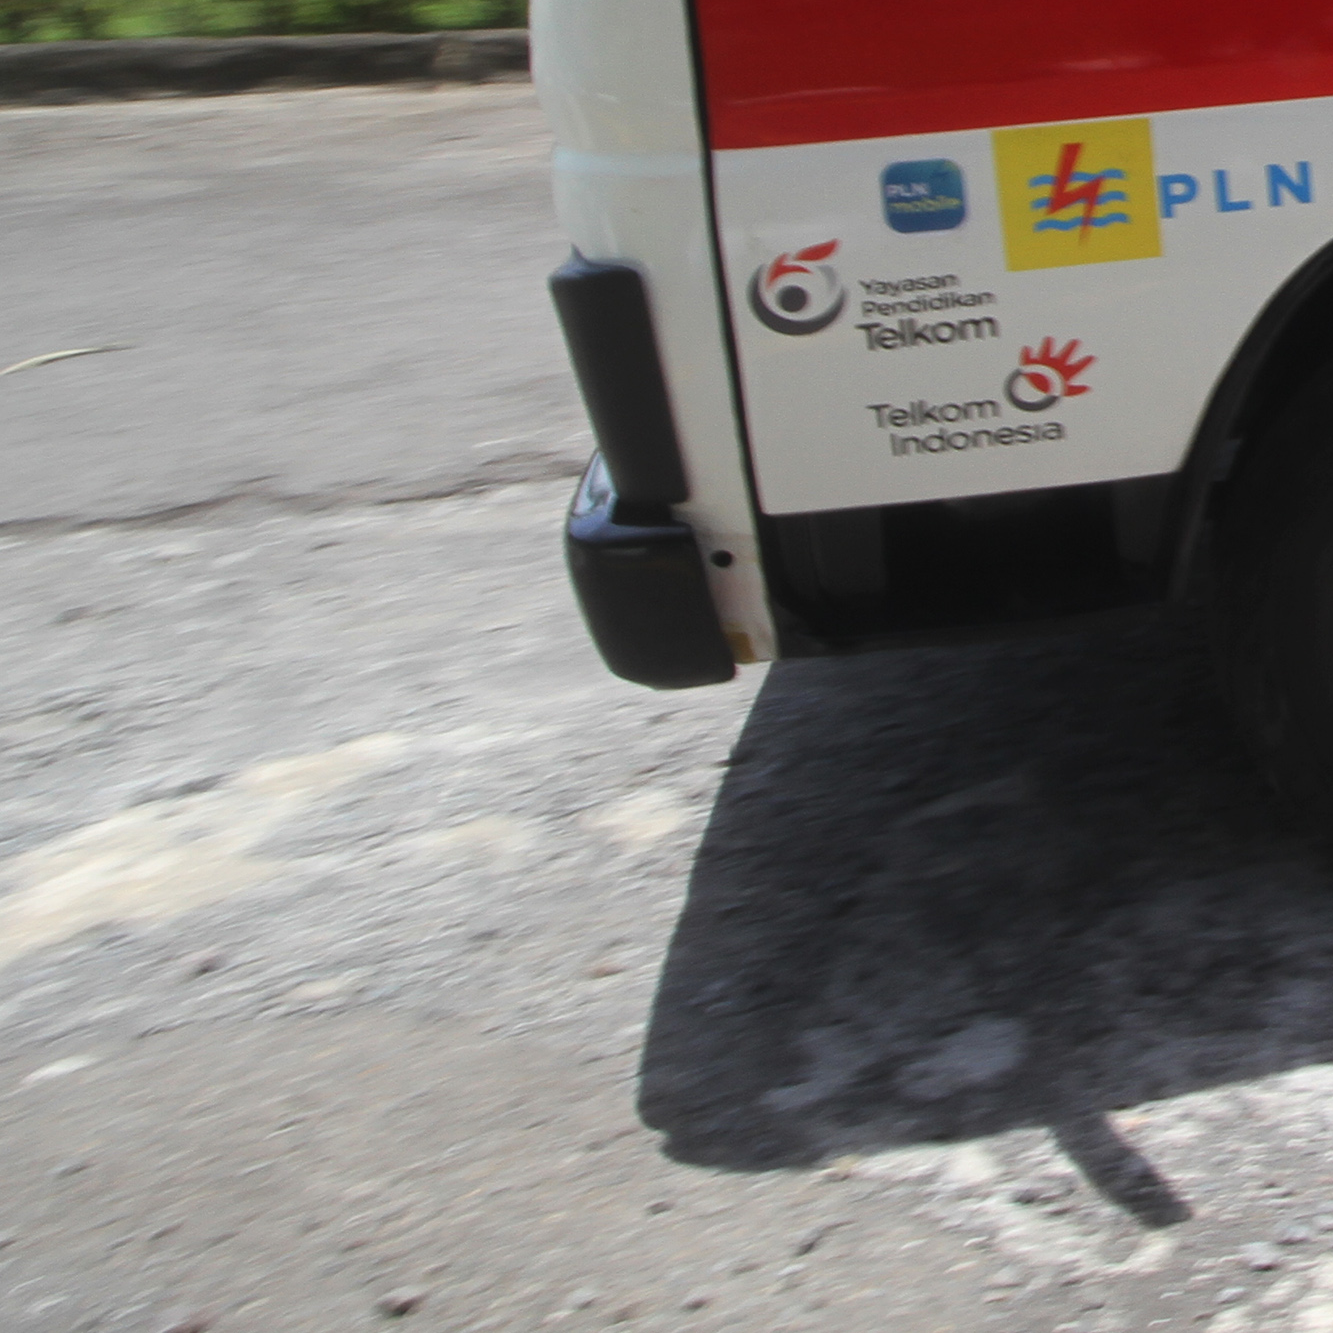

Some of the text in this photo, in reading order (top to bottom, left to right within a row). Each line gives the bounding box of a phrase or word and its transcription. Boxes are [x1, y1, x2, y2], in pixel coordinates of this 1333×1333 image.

[885, 182, 930, 198] PLN
[1156, 160, 1315, 218] PLN
[890, 195, 963, 213] mobile
[859, 274, 960, 296] Yayasan
[860, 291, 996, 316] Pendidikan
[855, 316, 999, 350] Telkom
[866, 399, 1000, 428] Telkom
[889, 422, 1066, 456] Indonesia
